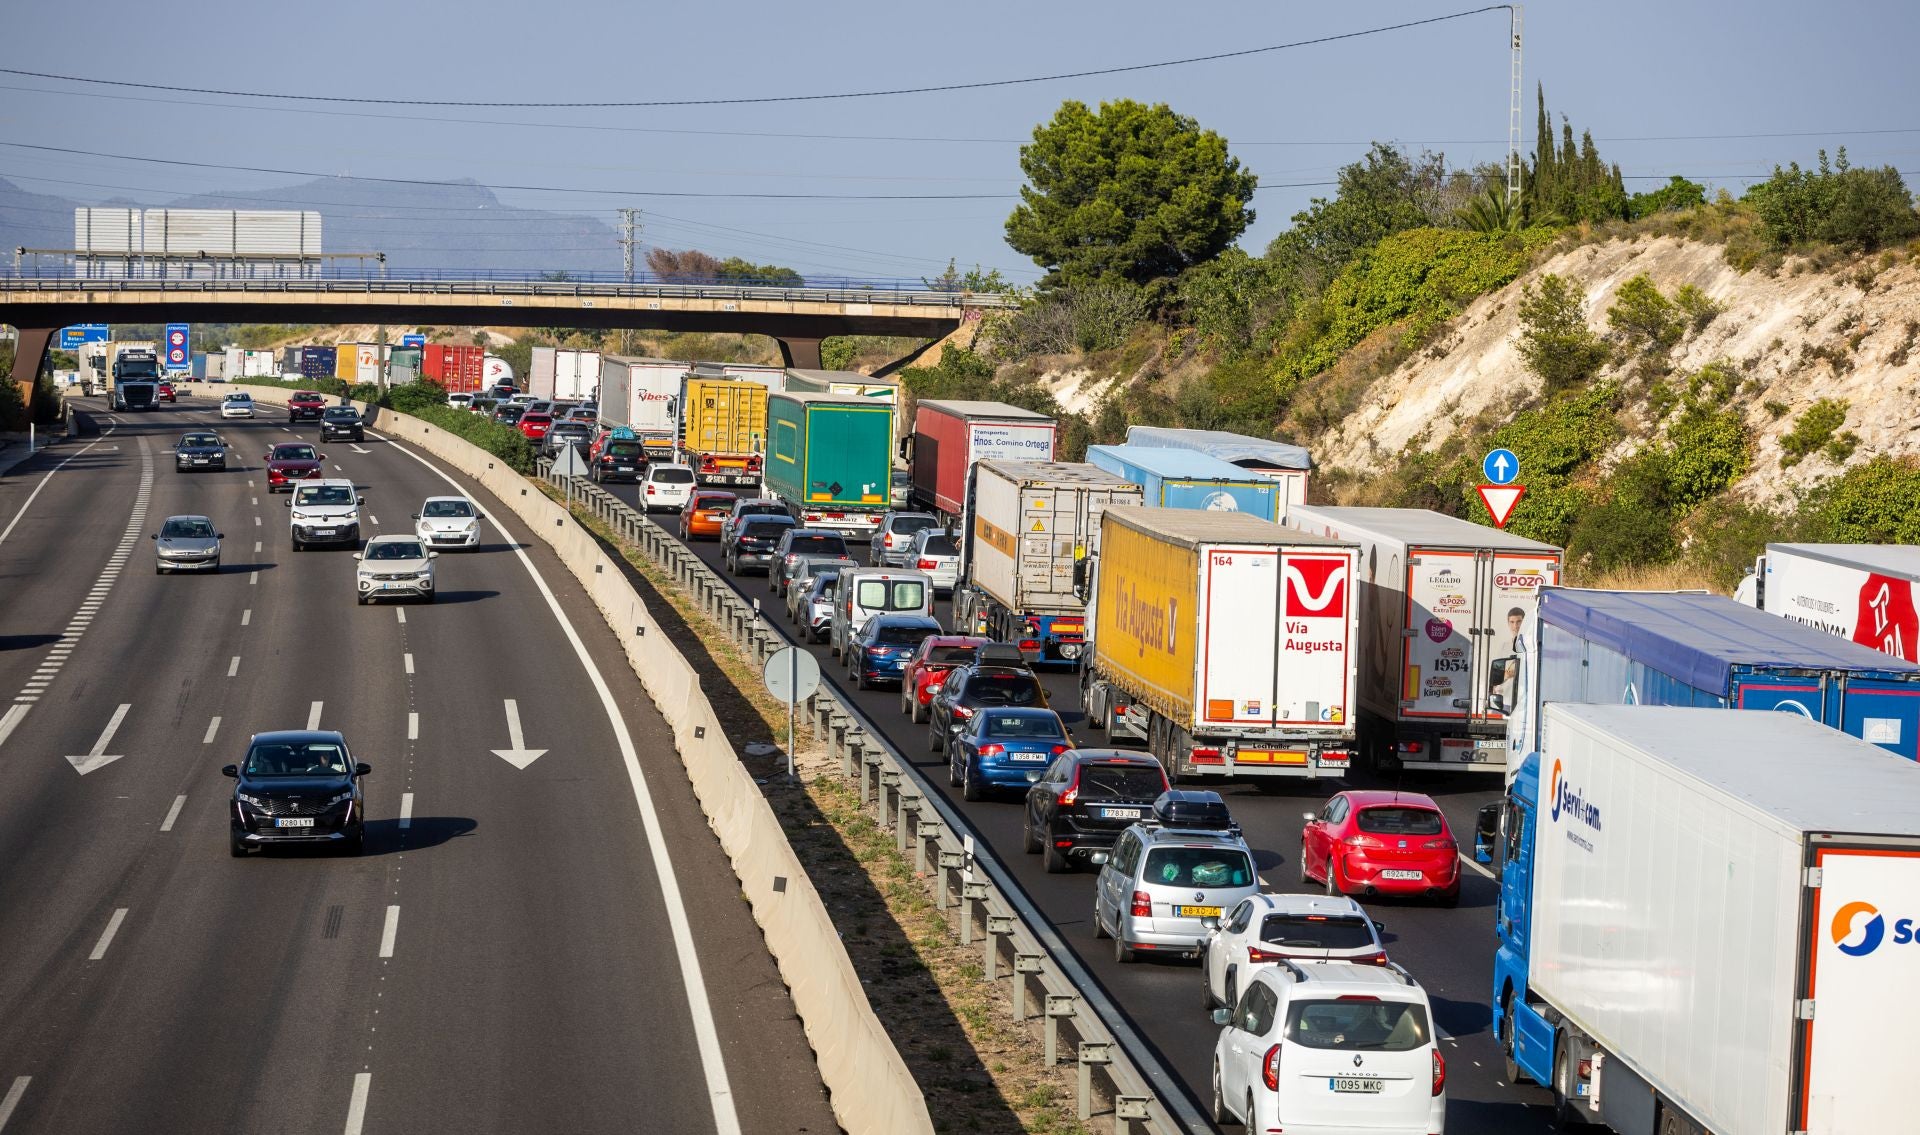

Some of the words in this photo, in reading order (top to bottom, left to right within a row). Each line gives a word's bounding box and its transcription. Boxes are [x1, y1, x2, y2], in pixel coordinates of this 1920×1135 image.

[1025, 440, 1049, 451] Ortega
[1213, 556, 1233, 566] 164
[1129, 581, 1164, 658] Augusta
[1285, 621, 1309, 635] Vía
[1285, 638, 1343, 654] Augusta
[1434, 658, 1469, 673] 1954
[1459, 749, 1489, 762] SOR
[280, 819, 298, 827] 9280
[299, 819, 313, 827] LYY
[1386, 870, 1404, 878] 6924
[1336, 1079, 1360, 1090] 1095
[1363, 1081, 1383, 1090] MKC
